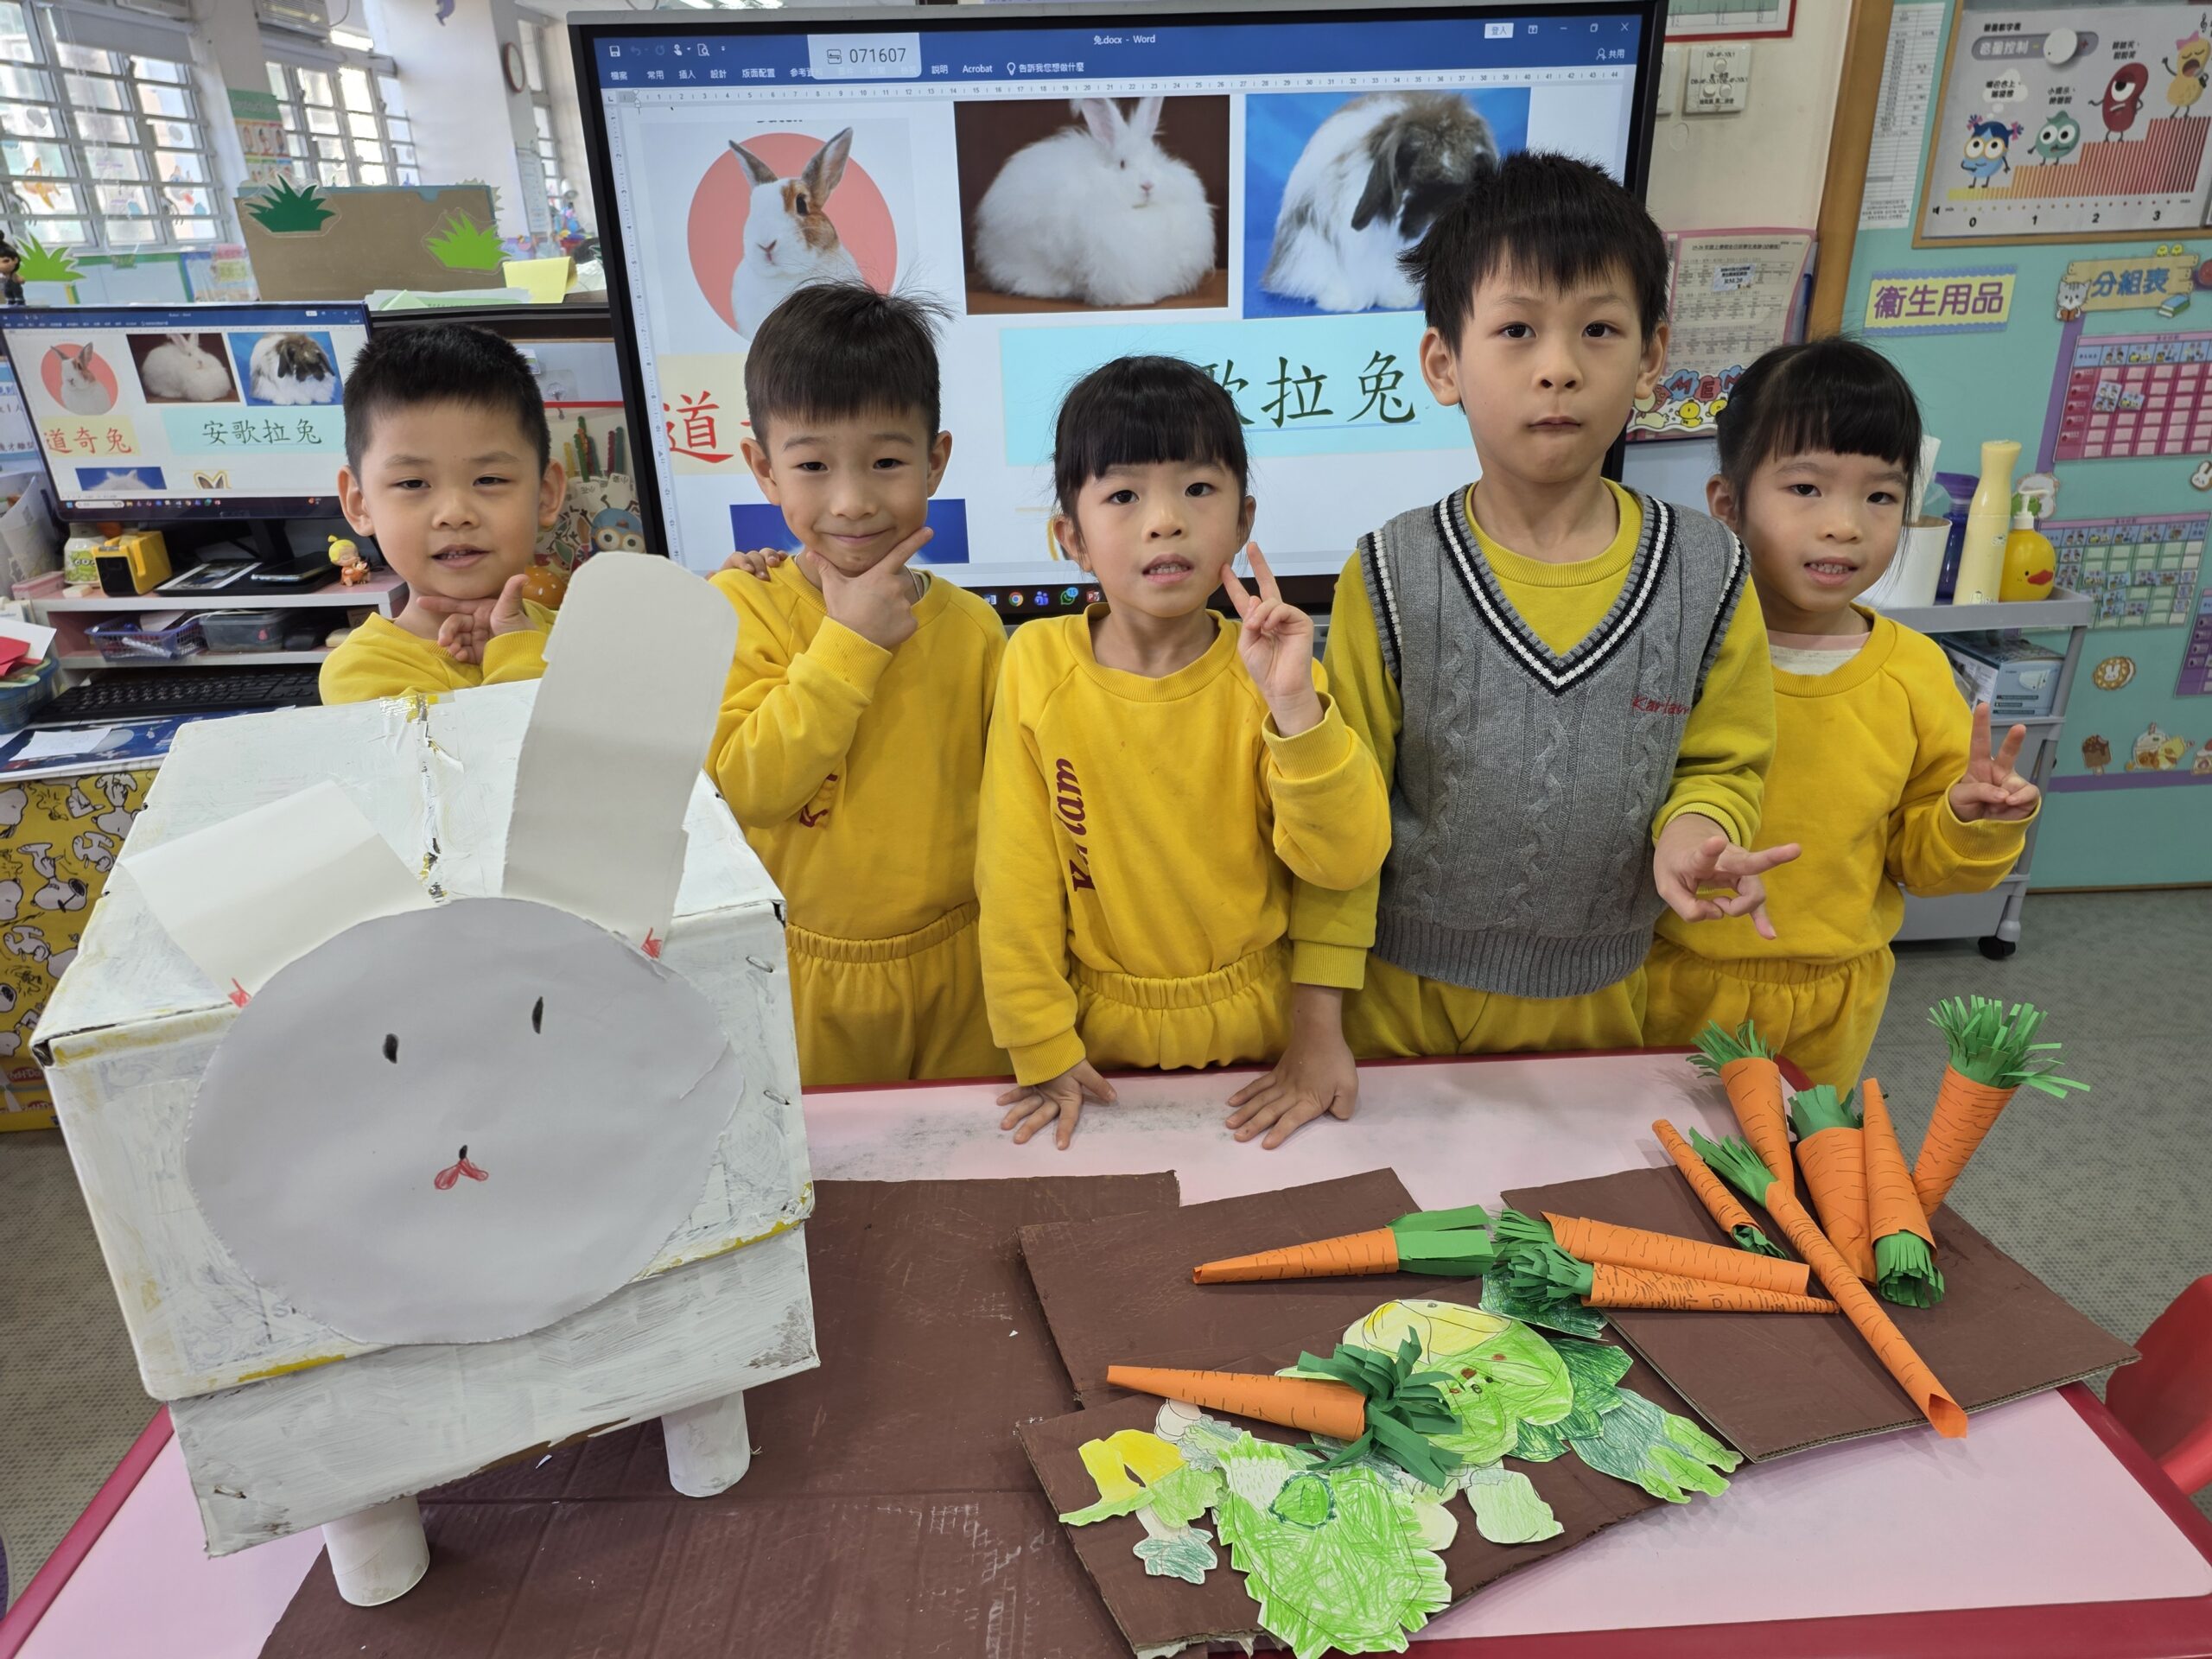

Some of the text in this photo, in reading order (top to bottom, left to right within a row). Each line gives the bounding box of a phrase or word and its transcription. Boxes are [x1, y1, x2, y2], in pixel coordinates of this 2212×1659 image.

[1133, 35, 1156, 43] Word
[1491, 27, 1507, 35] 登入
[849, 48, 906, 63] 071607
[1608, 49, 1624, 59] 共用
[611, 71, 628, 80] 檔案
[647, 70, 664, 79] 常用
[679, 69, 696, 79] 插入
[710, 69, 727, 79] 設計
[742, 67, 776, 79] 版面配置
[931, 65, 949, 74] 說明
[963, 64, 993, 73] Acrobat
[1969, 211, 2161, 227] 0 1 2 3
[2090, 268, 2171, 299] 分組表
[203, 418, 322, 446] 安歌拉兔
[663, 391, 753, 464] 道
[44, 426, 132, 454] 道奇兔
